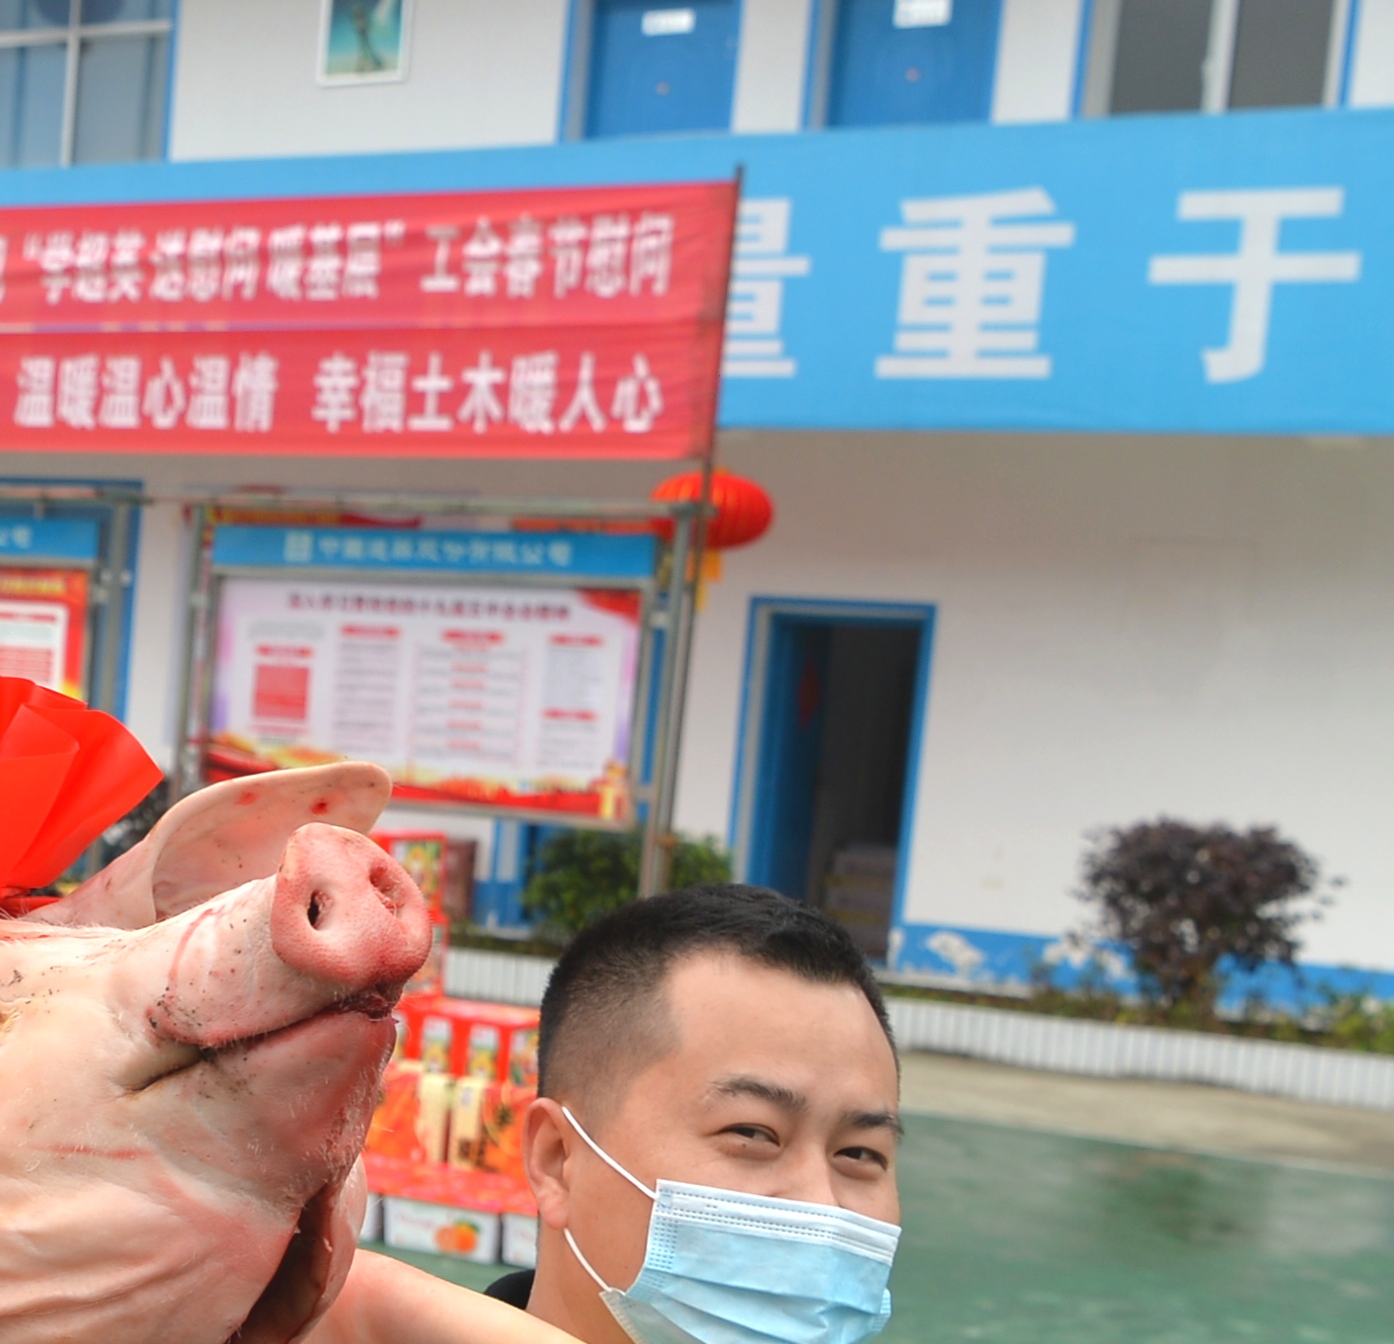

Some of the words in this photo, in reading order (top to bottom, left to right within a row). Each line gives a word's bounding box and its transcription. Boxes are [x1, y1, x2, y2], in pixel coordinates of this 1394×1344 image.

[12, 353, 279, 432] 温暖温心温情
[310, 351, 664, 436] 幸福土木暖人心
